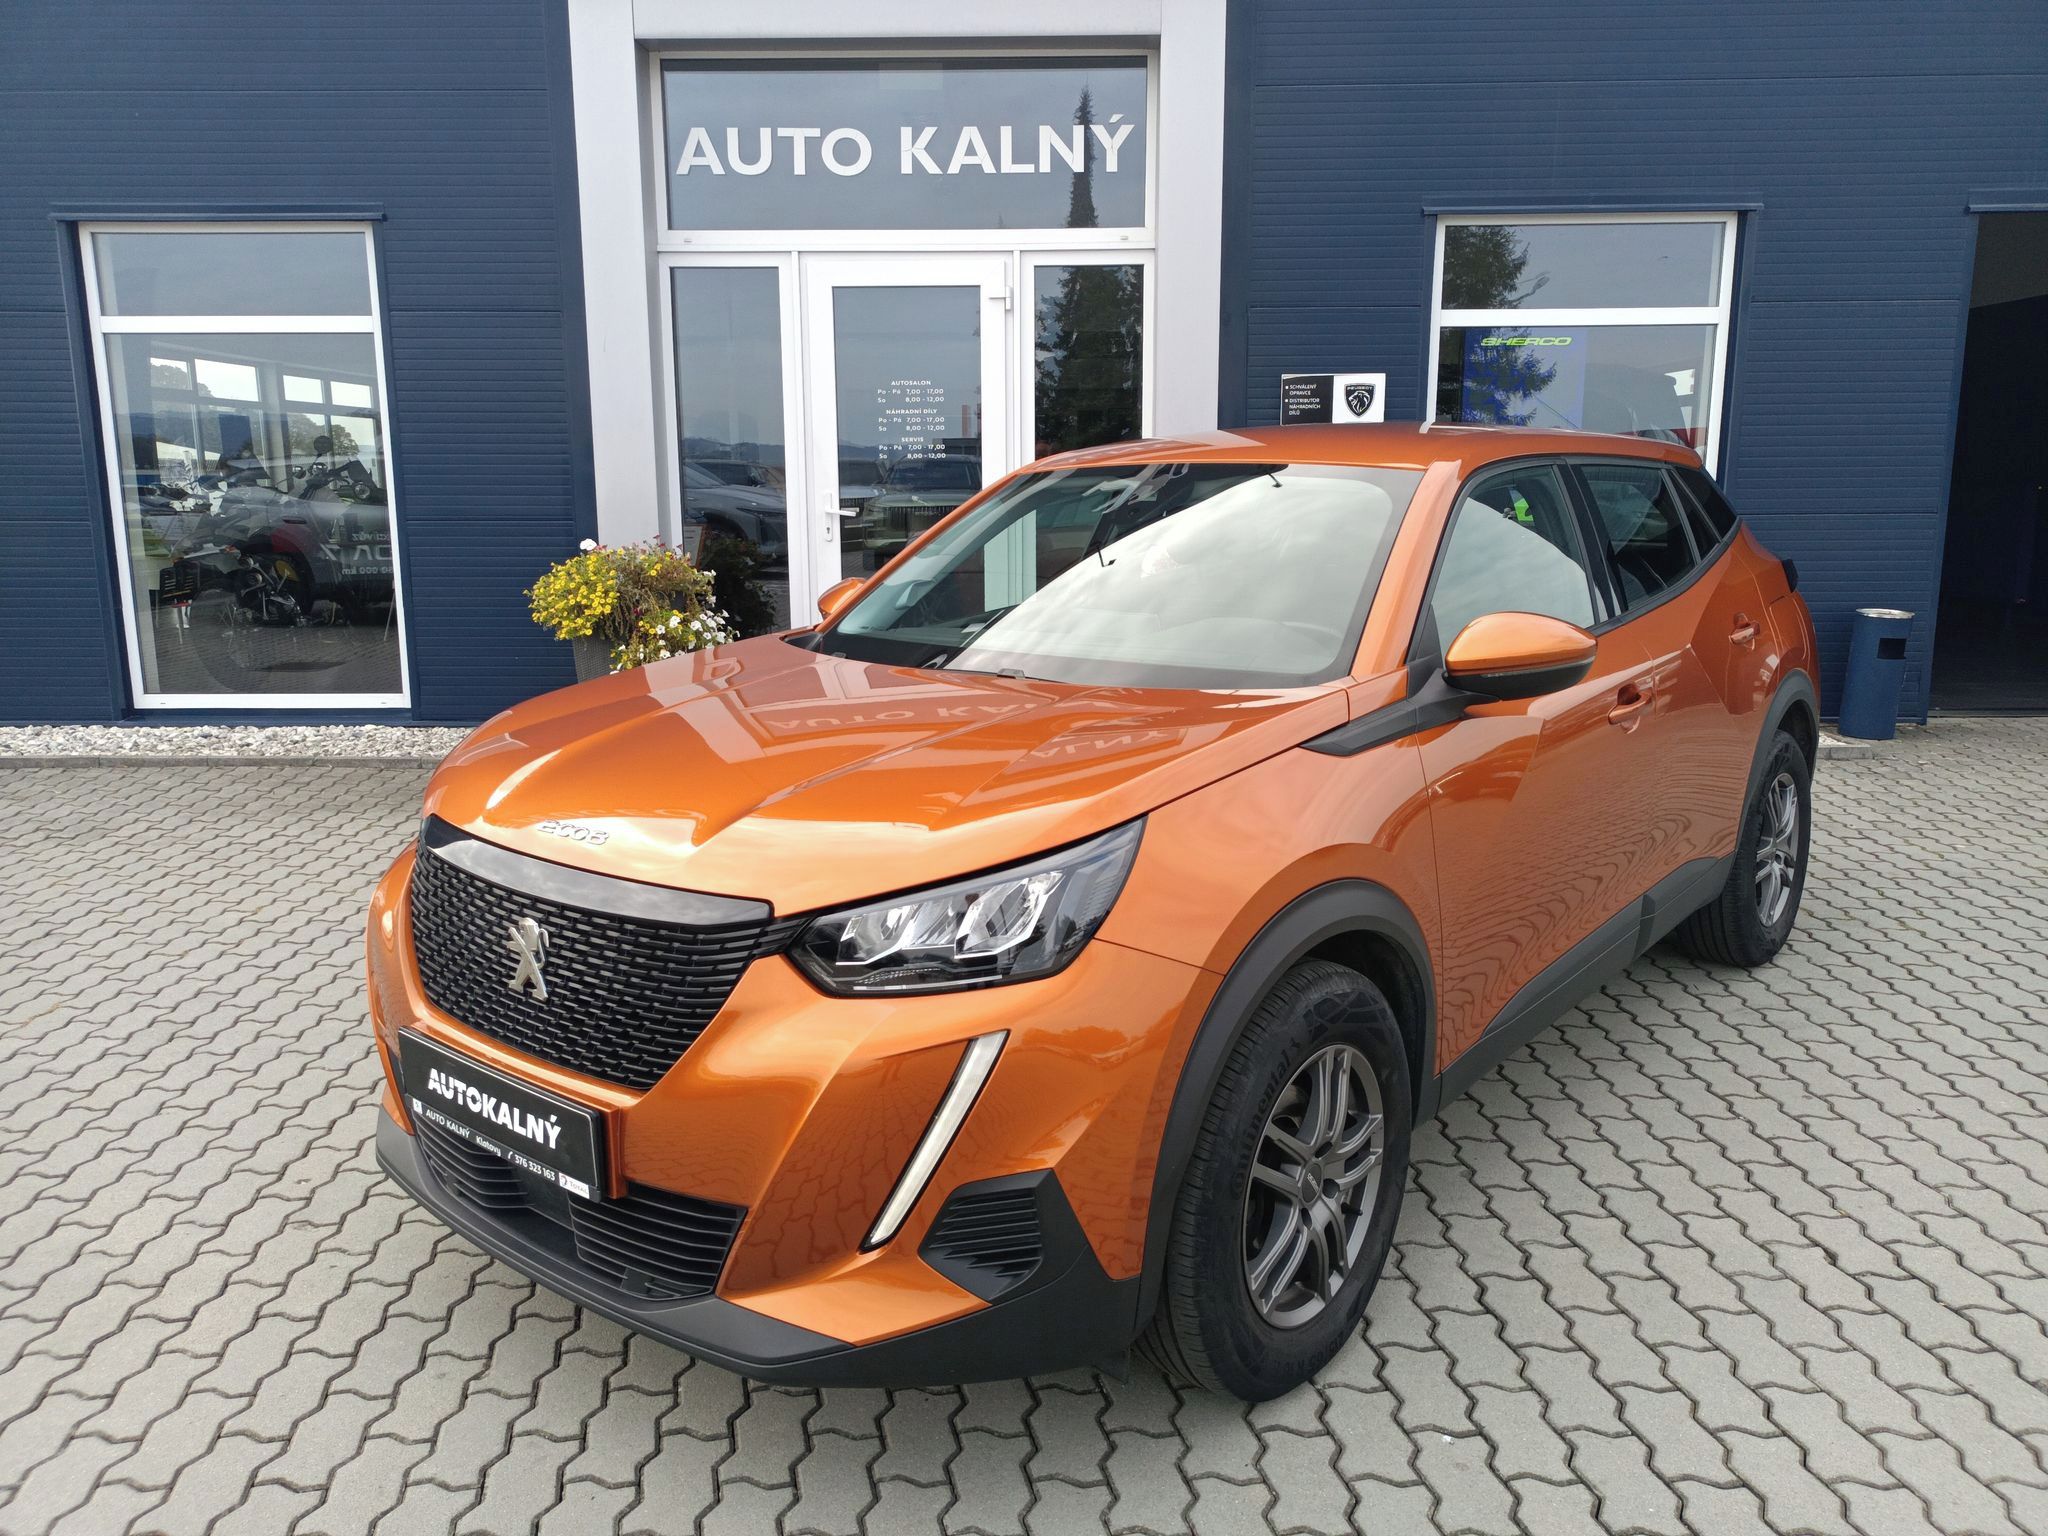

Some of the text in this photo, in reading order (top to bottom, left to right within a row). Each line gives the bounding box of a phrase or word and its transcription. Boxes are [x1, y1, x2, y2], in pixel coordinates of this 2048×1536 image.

[676, 113, 1135, 177] AUTO KALNÝ
[1480, 336, 1573, 346] SHERCO
[537, 818, 610, 846] 2008
[425, 1109, 445, 1126] AUTO
[446, 1120, 472, 1139] KALNÝ
[475, 1135, 502, 1157] Klatovy
[514, 1154, 528, 1169] 376
[528, 1161, 542, 1175] 323
[542, 1167, 556, 1181] 163
